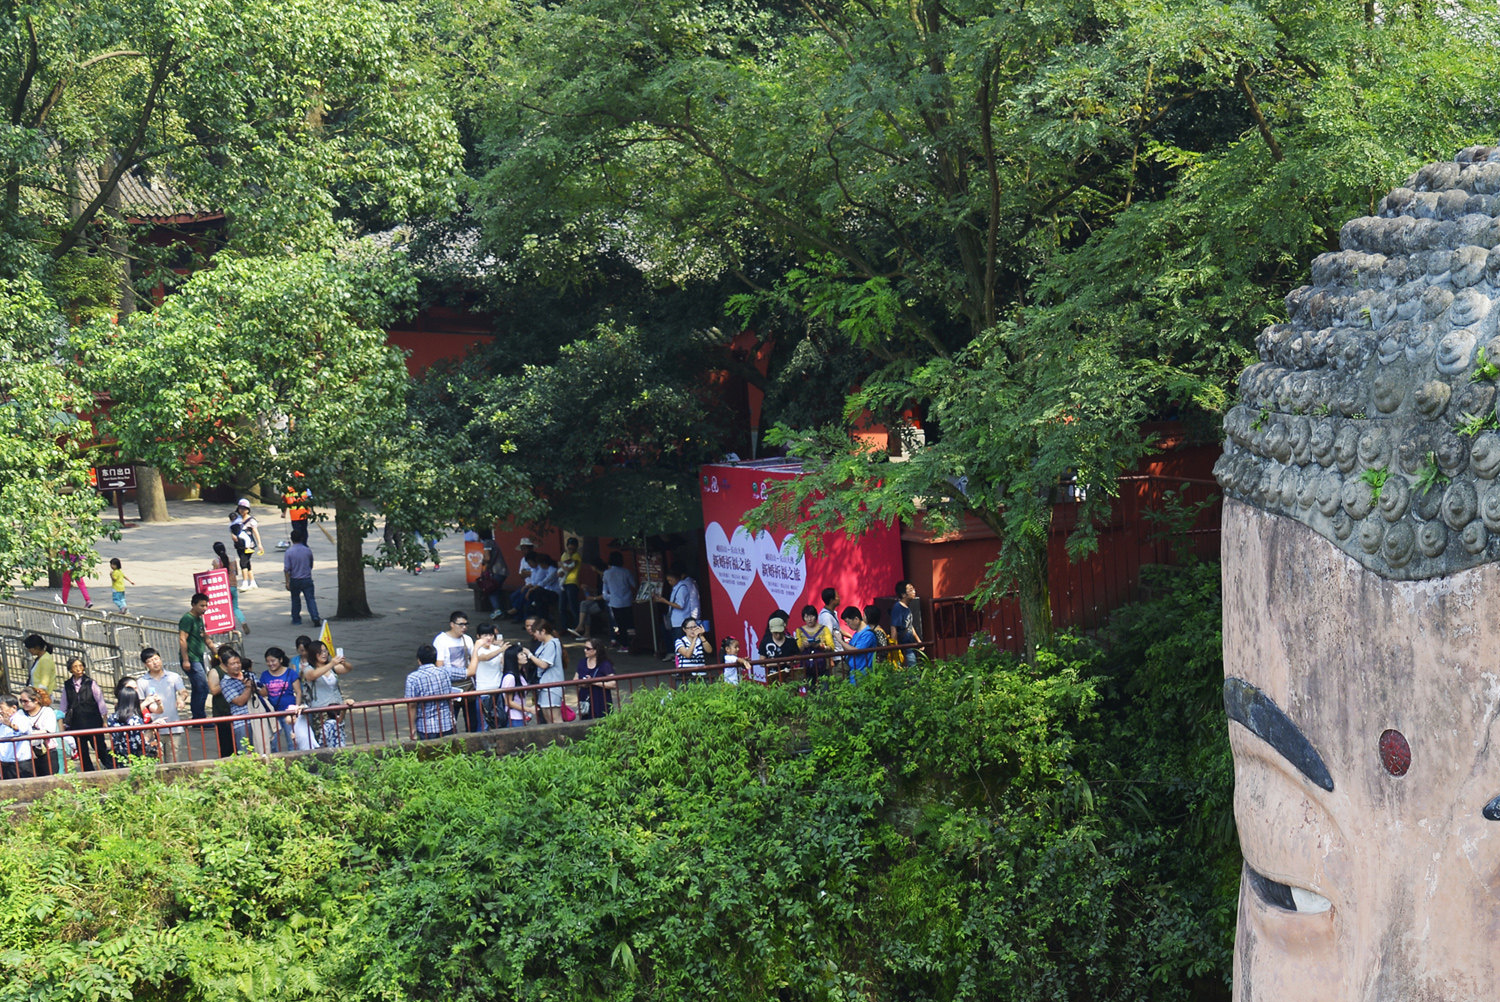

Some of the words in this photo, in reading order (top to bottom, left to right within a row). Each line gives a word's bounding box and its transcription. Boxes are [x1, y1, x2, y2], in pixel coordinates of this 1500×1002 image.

[102, 468, 131, 477] 东门出口
[712, 554, 752, 572] 新婚祈福之旅
[762, 563, 802, 581] 新婚祈福之旅
